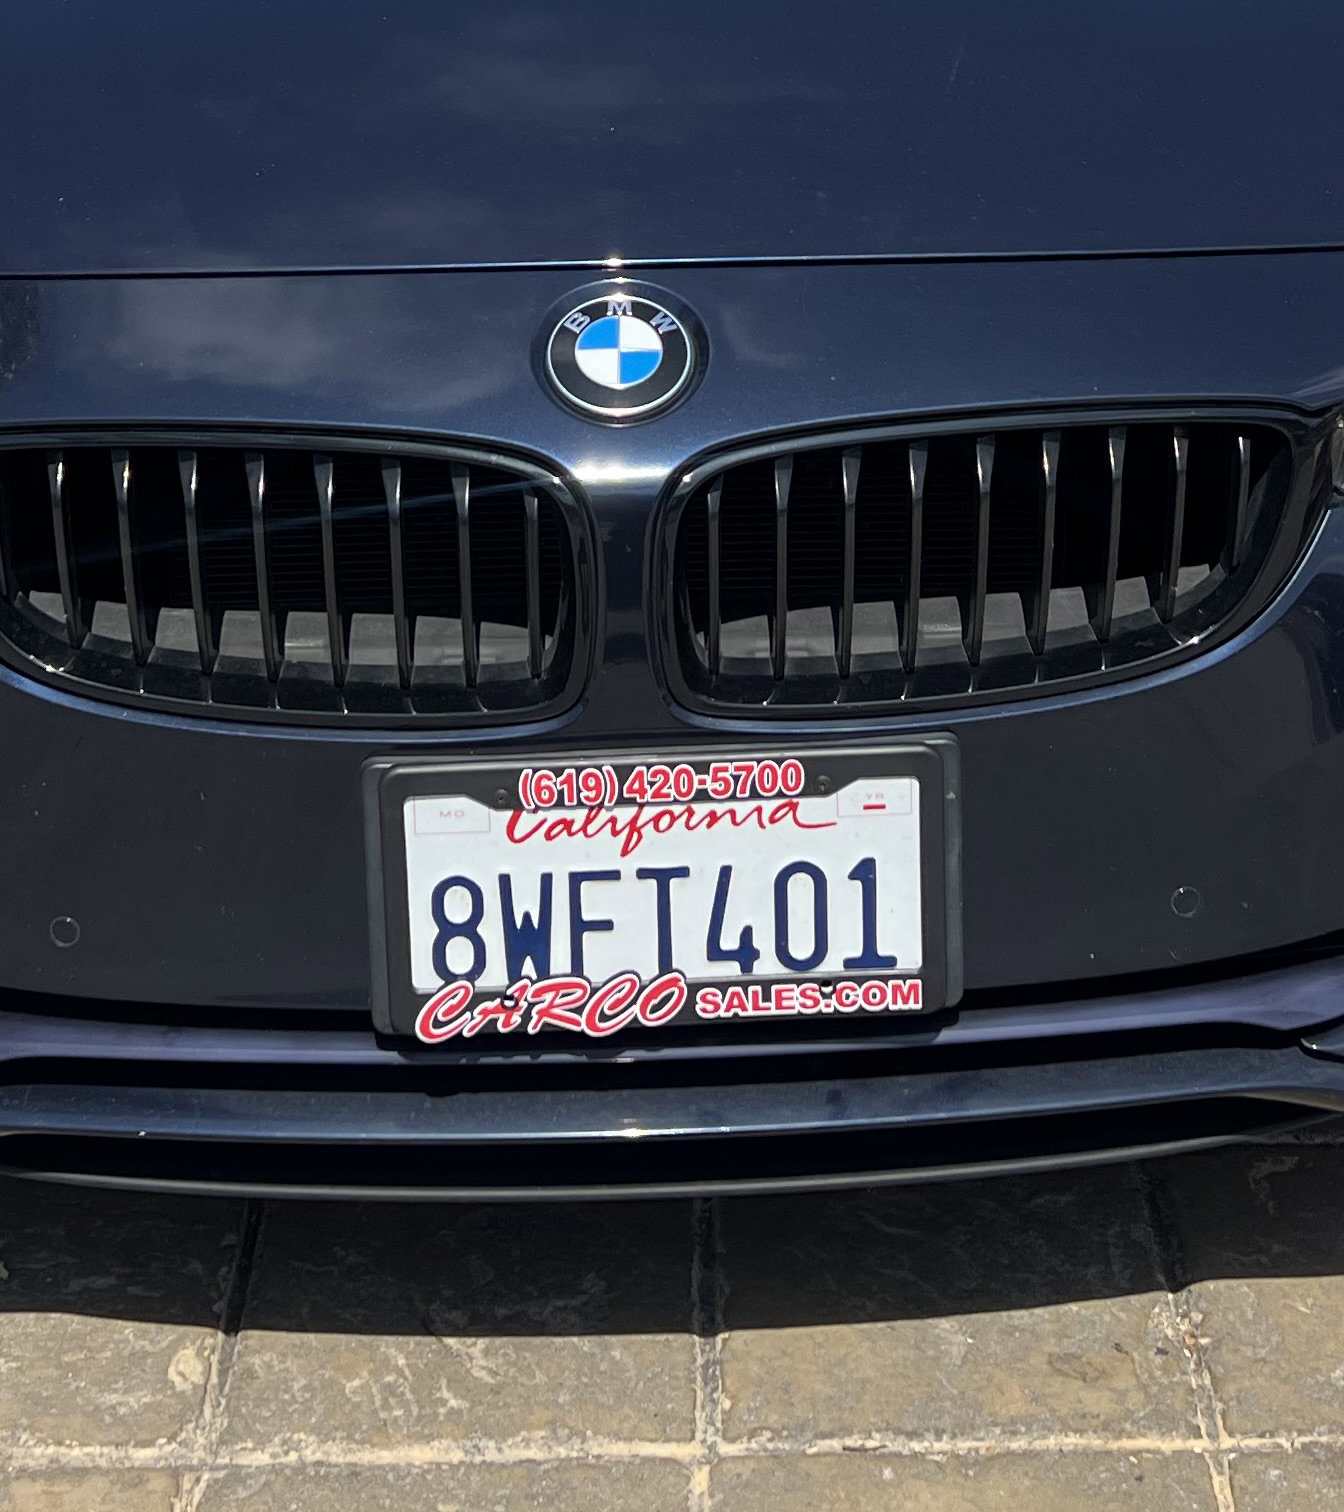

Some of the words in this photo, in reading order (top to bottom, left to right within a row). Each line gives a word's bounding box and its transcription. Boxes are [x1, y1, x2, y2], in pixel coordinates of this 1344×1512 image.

[563, 300, 678, 335] BMW
[519, 765, 616, 807] (619)
[624, 759, 805, 803] 420-5700
[506, 800, 838, 858] California
[431, 857, 898, 984] 8WFT401
[414, 972, 688, 1044] CARCO
[695, 979, 923, 1018] SALES.COM
